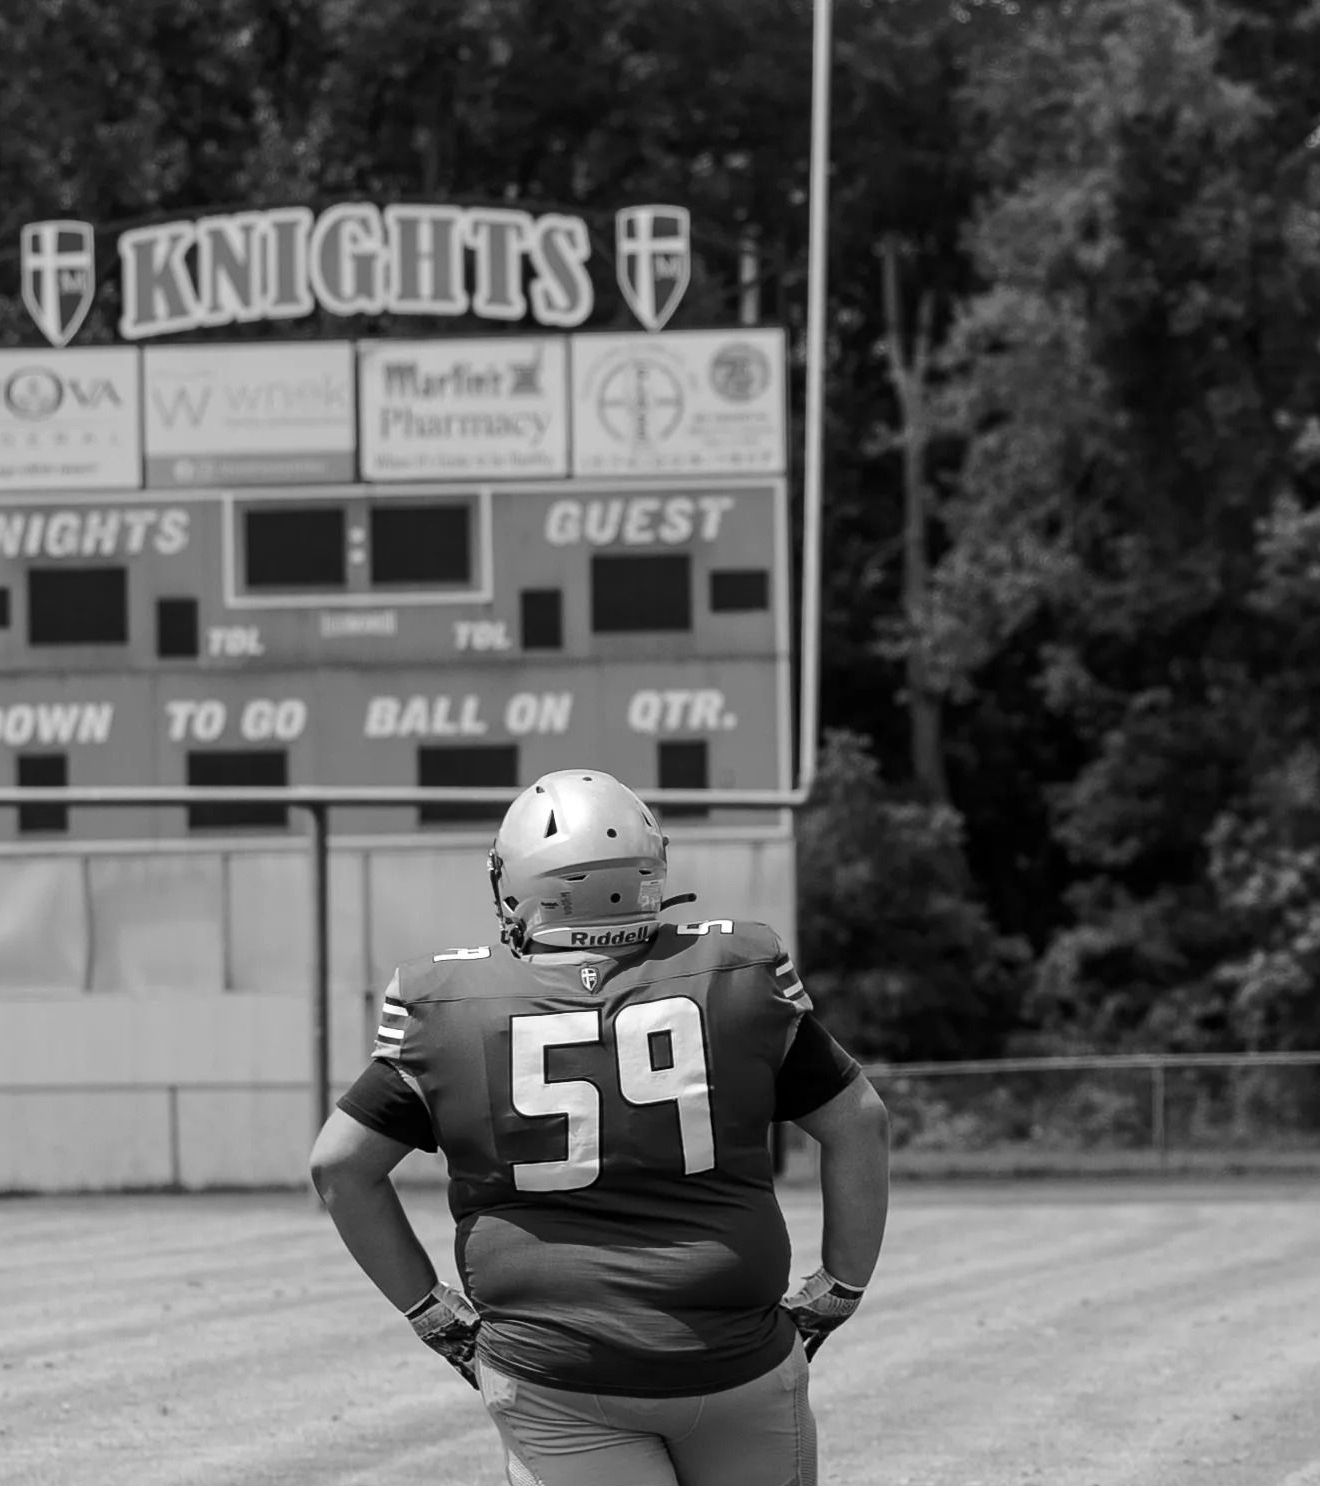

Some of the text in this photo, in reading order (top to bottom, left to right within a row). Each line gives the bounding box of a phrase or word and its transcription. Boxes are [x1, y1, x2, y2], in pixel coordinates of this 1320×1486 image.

[119, 202, 593, 338] KNIGHTS
[379, 404, 555, 449] Pharmacy
[544, 497, 735, 545] GUEST
[165, 698, 308, 741] TO GO
[364, 692, 574, 738] BALL ON
[627, 689, 739, 733] QTR.
[571, 924, 649, 946] Riddell
[509, 996, 717, 1193] 59
